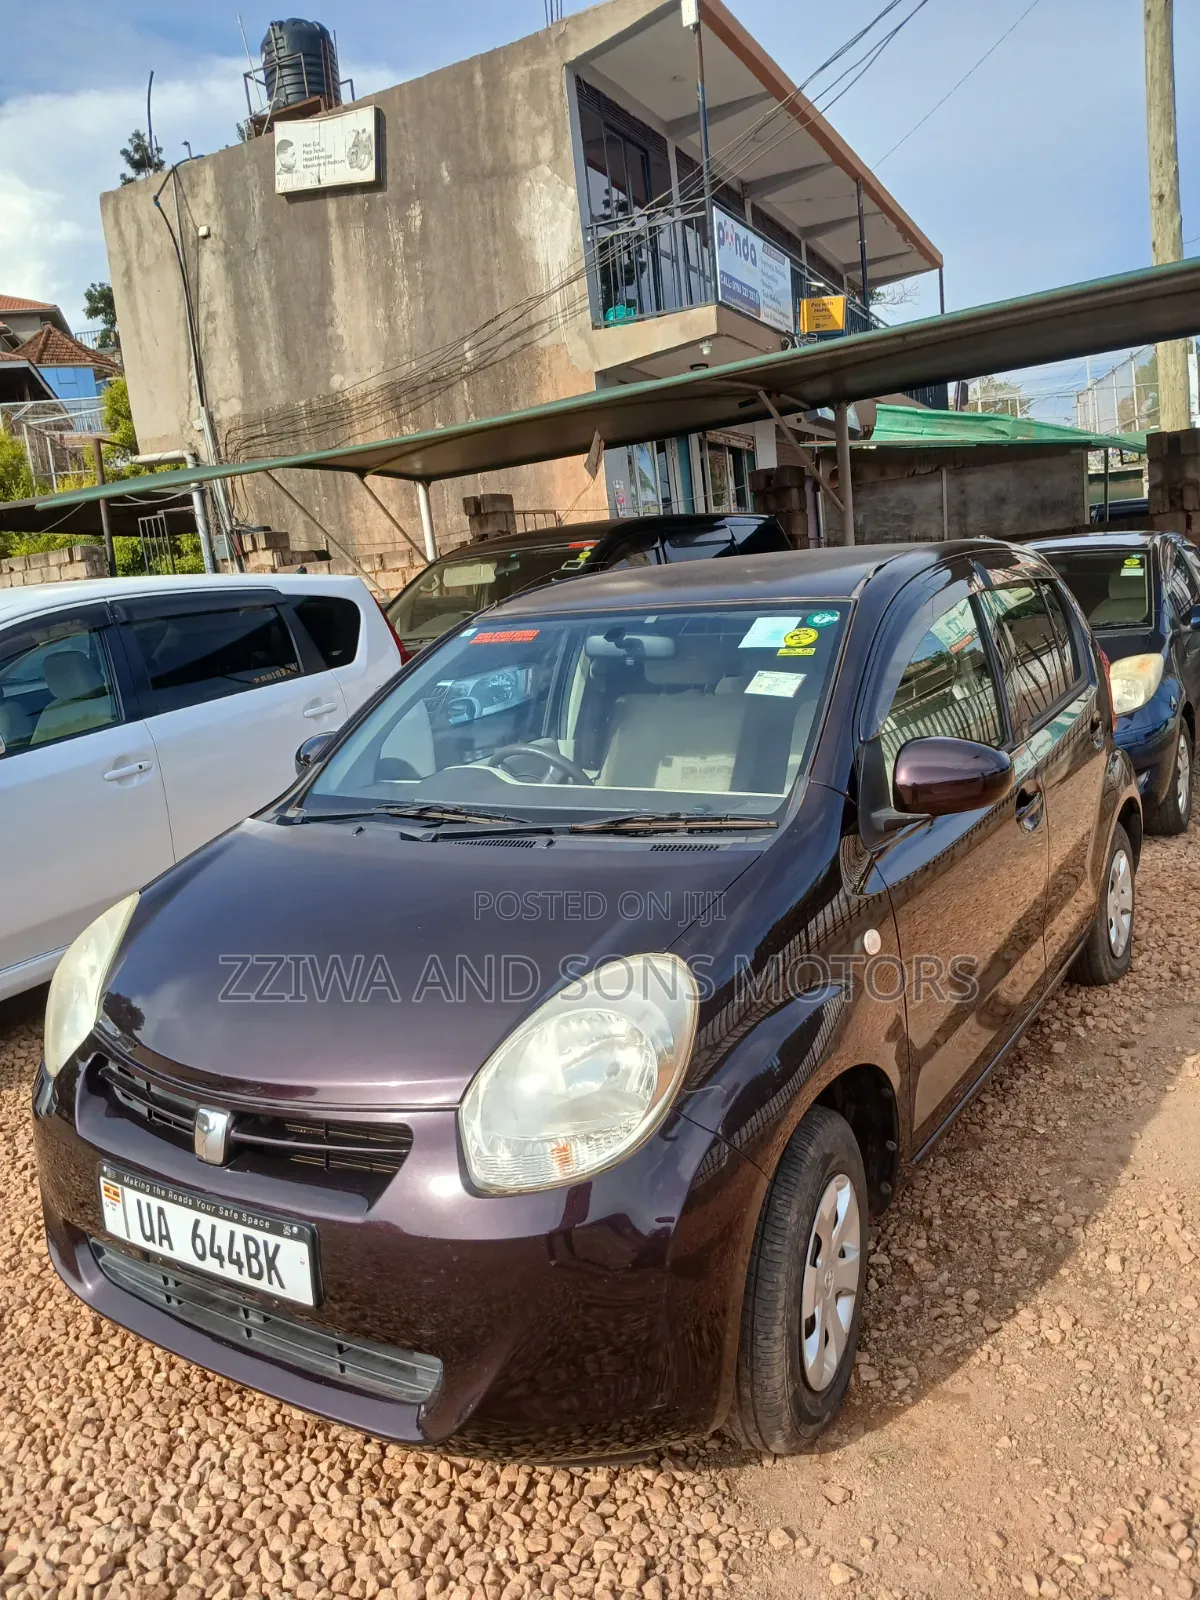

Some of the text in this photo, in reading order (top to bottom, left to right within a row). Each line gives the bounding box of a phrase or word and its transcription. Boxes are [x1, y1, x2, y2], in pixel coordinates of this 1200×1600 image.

[123, 1174, 270, 1229] Making the Roads Your Safe Space
[136, 1198, 286, 1290] UA 644BK
